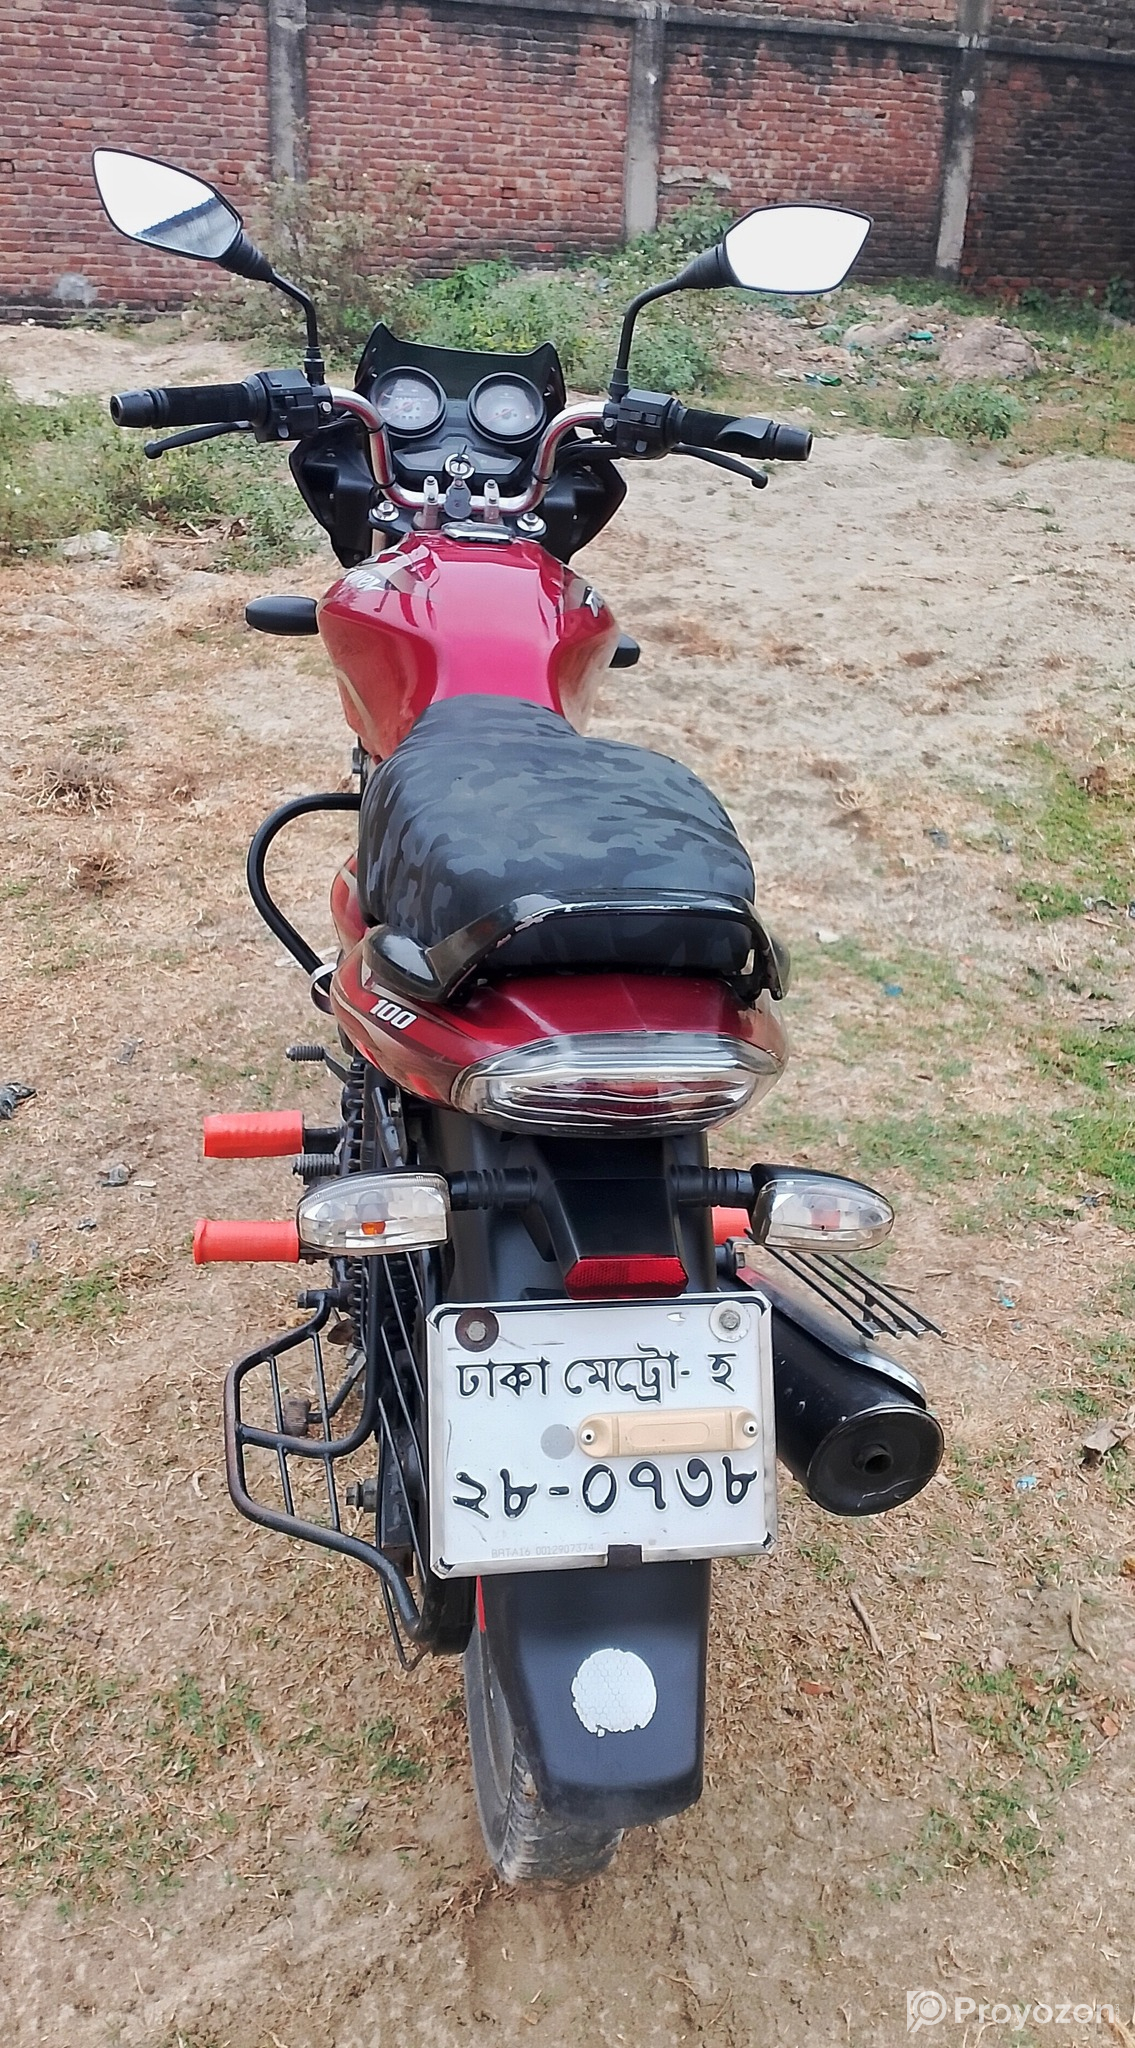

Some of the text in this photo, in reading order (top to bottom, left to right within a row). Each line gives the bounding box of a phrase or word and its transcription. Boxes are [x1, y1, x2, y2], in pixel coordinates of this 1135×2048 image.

[369, 1000, 418, 1029] 100
[456, 1356, 551, 1397] ঢাকা
[707, 1352, 738, 1392] হ
[452, 1456, 758, 1519] ২৮-০৭৩৮
